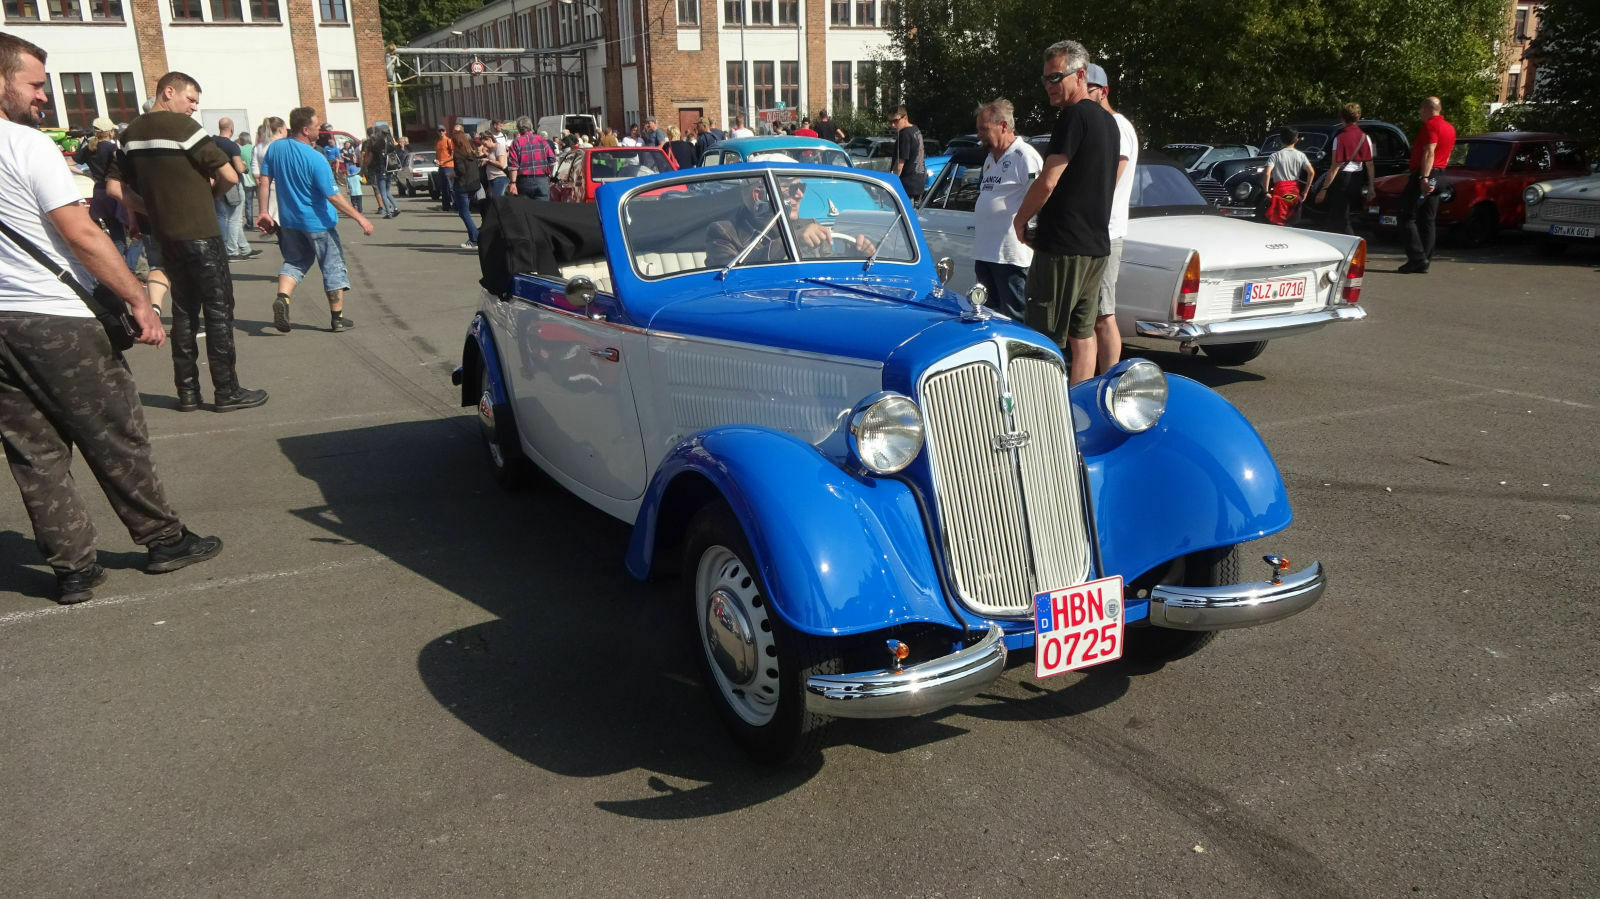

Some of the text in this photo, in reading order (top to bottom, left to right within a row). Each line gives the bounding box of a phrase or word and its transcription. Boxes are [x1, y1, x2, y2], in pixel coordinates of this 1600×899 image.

[1251, 284, 1272, 300] SLZ
[1041, 618, 1049, 629] D
[1052, 587, 1104, 631] HBN
[1043, 622, 1118, 670] 0725
